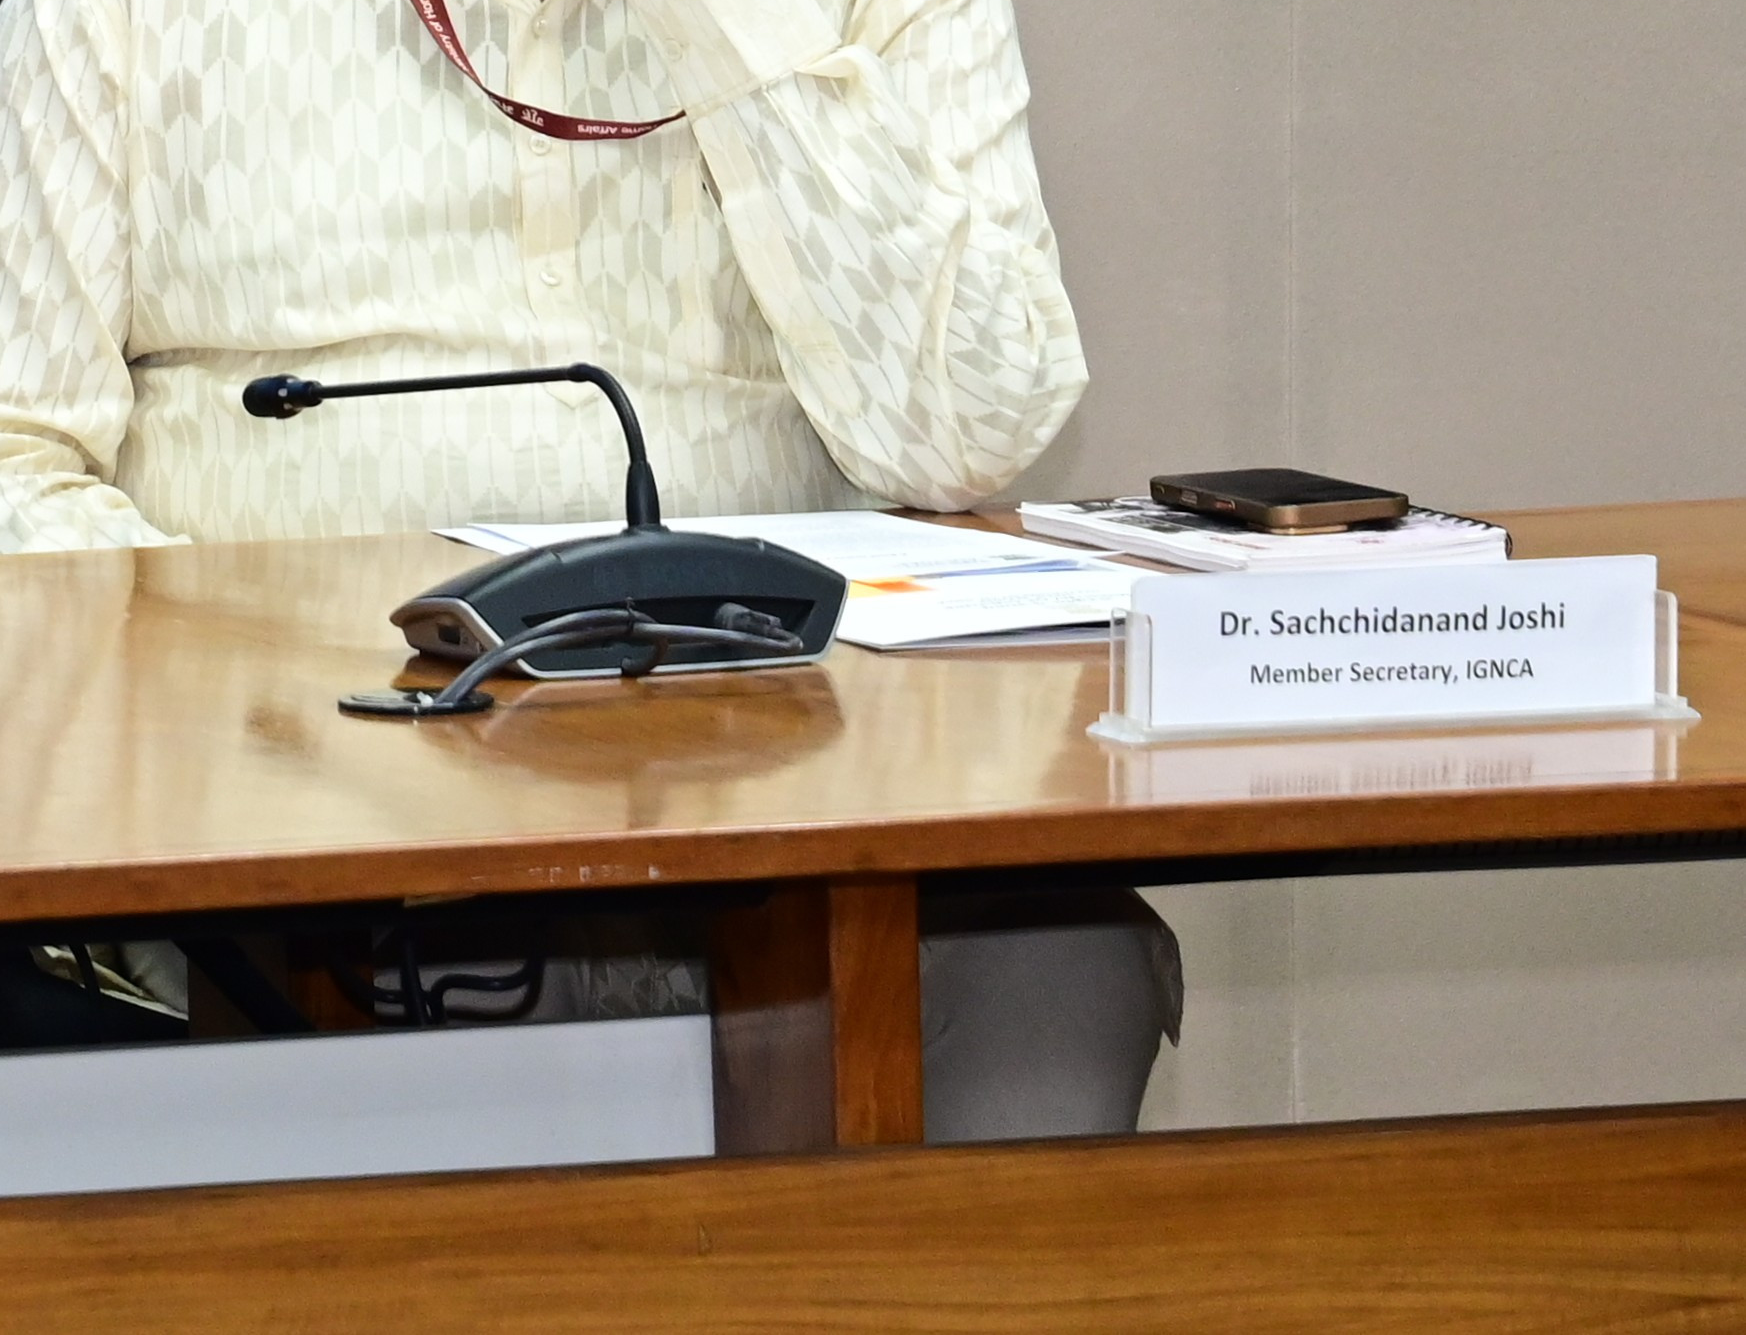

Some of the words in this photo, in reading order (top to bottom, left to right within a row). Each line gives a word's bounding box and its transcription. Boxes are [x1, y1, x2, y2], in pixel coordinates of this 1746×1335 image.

[430, 15, 445, 34] of
[520, 107, 545, 128] गृह
[577, 124, 618, 135] Affairs
[1220, 610, 1260, 637] Dr.
[1269, 603, 1488, 636] Sachchidanand
[1496, 601, 1565, 632] Joshi
[1250, 661, 1344, 685] Member
[1349, 661, 1459, 686] Secretary,
[1466, 657, 1535, 680] IGNCA
